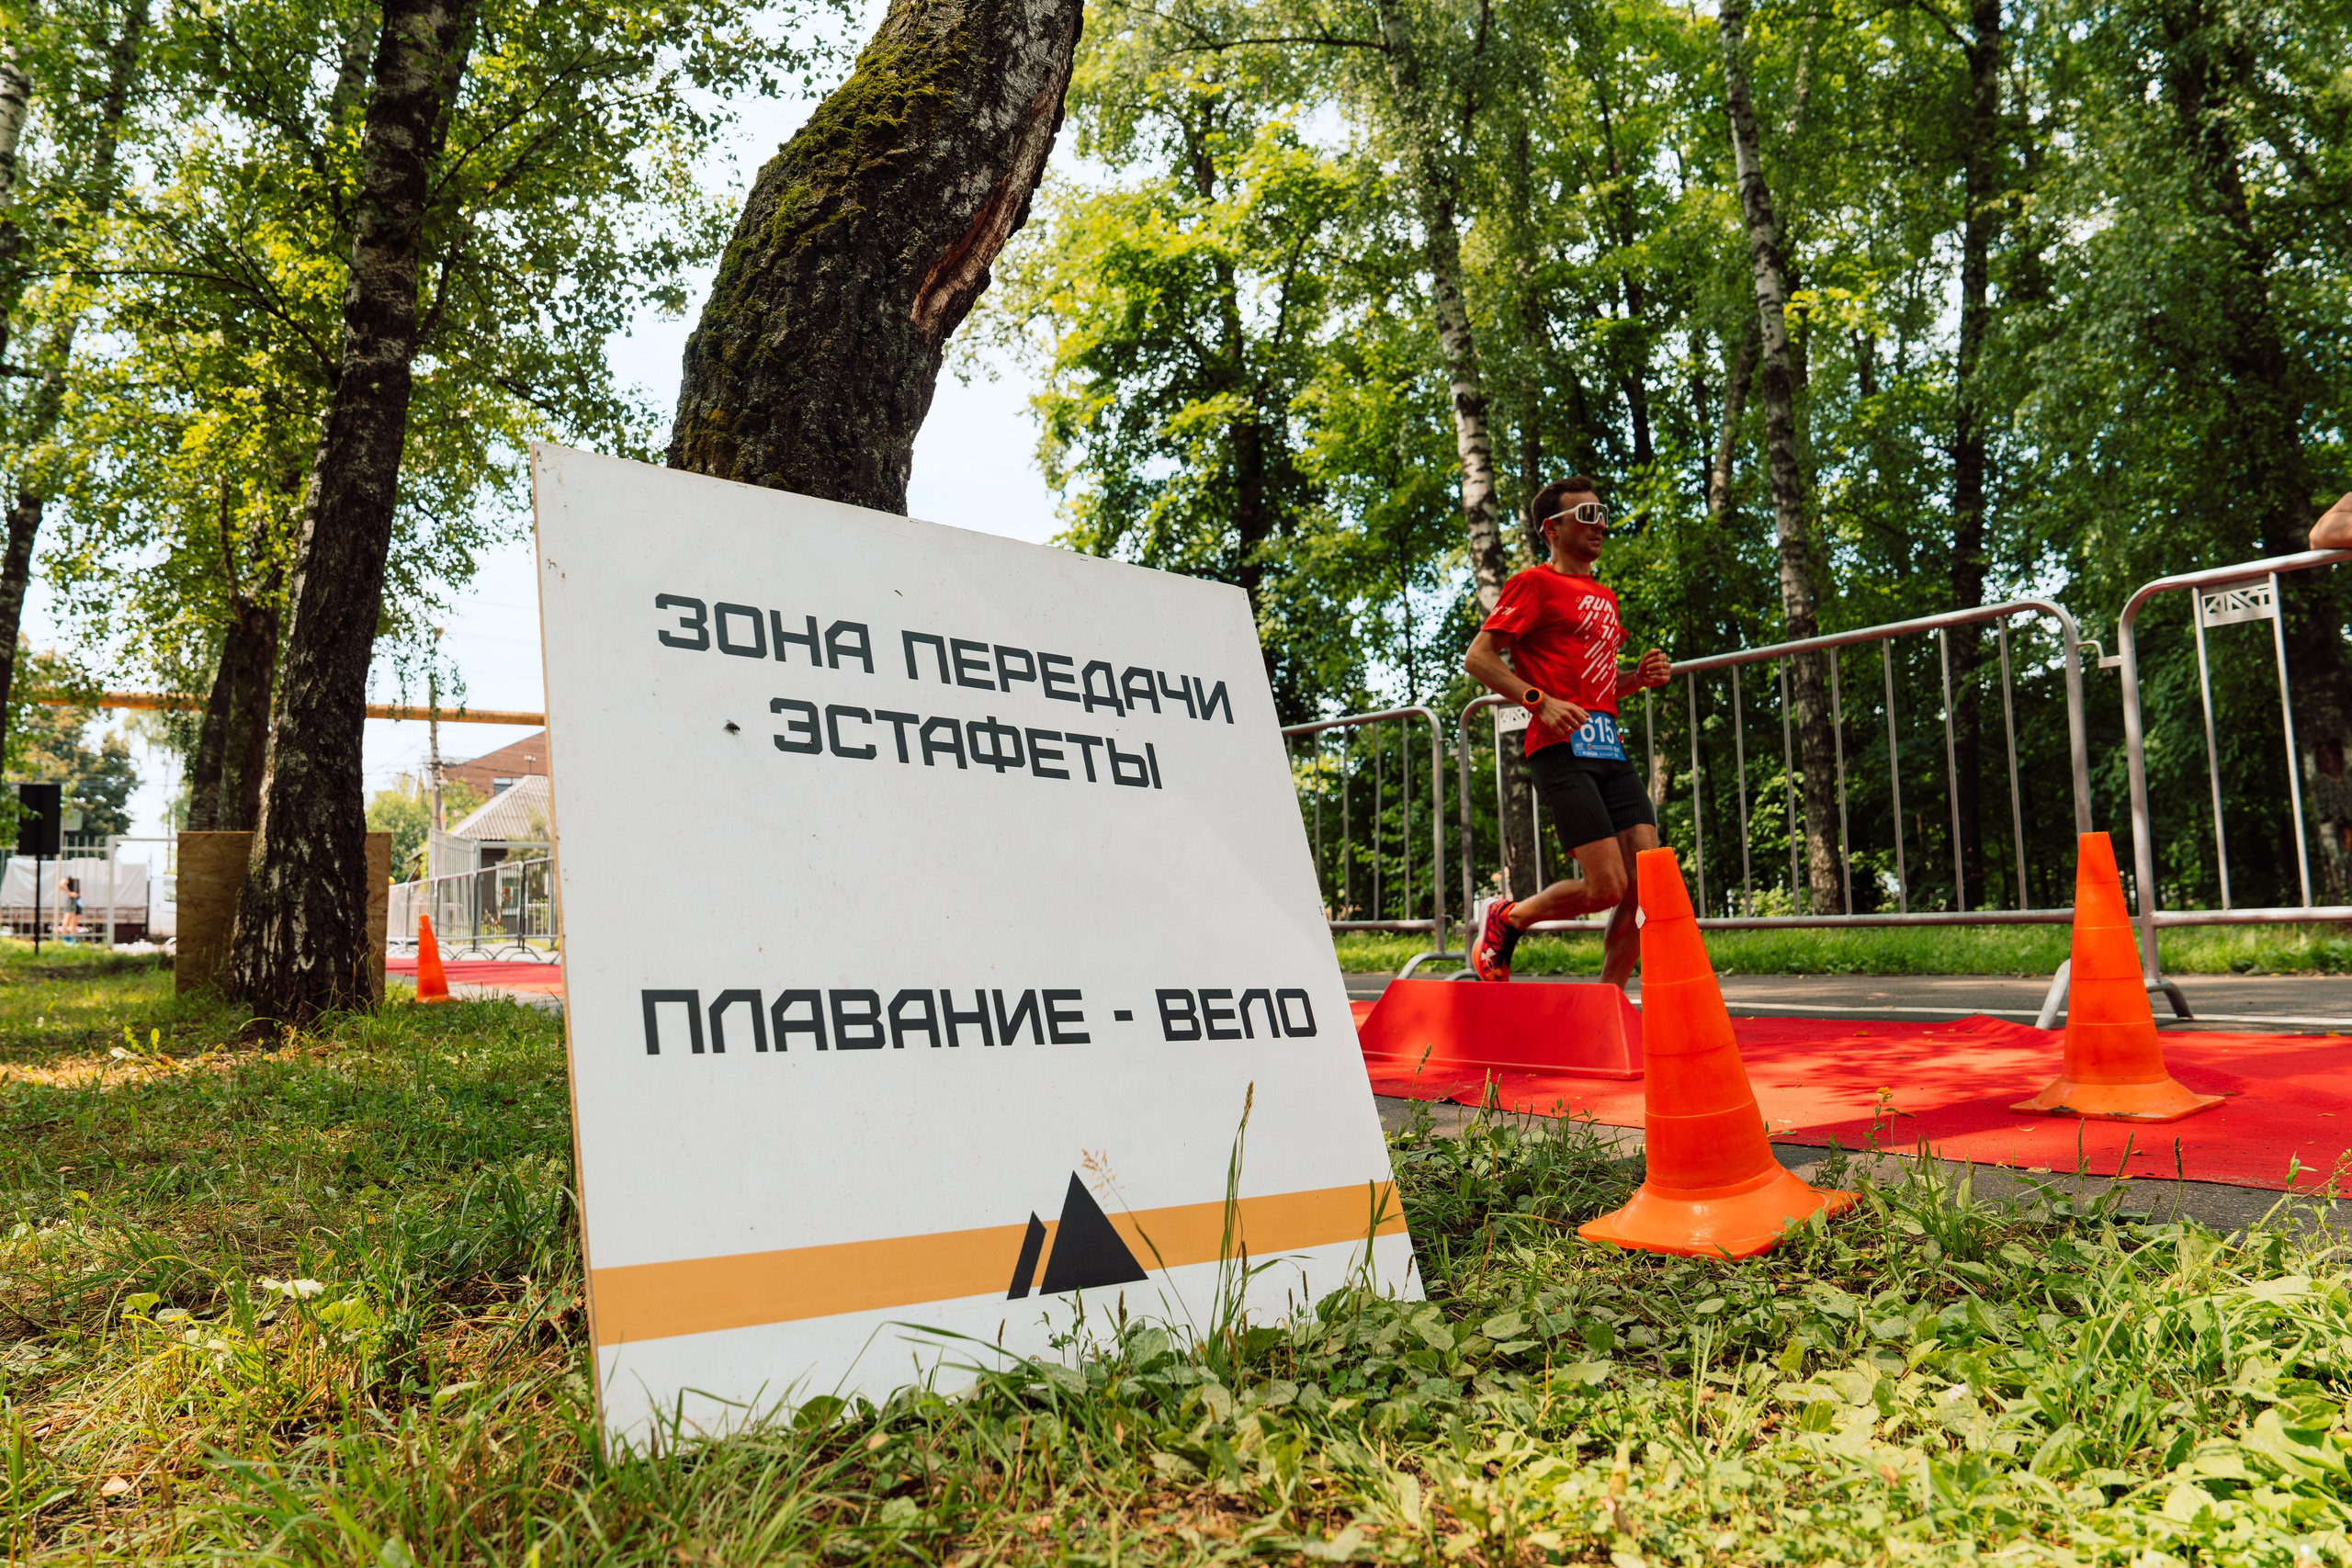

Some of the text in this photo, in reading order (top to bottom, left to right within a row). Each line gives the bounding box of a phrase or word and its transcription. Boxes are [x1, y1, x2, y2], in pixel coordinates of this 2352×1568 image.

[656, 593, 1234, 724] ЗОНА ПЕРЕДАЧИ
[770, 697, 1162, 789] ЭСТАФЕТЫ
[1580, 716, 1614, 744] 615
[641, 989, 1091, 1055] ПЛАВАНИЕ
[1155, 988, 1317, 1041] ВЕЛО
